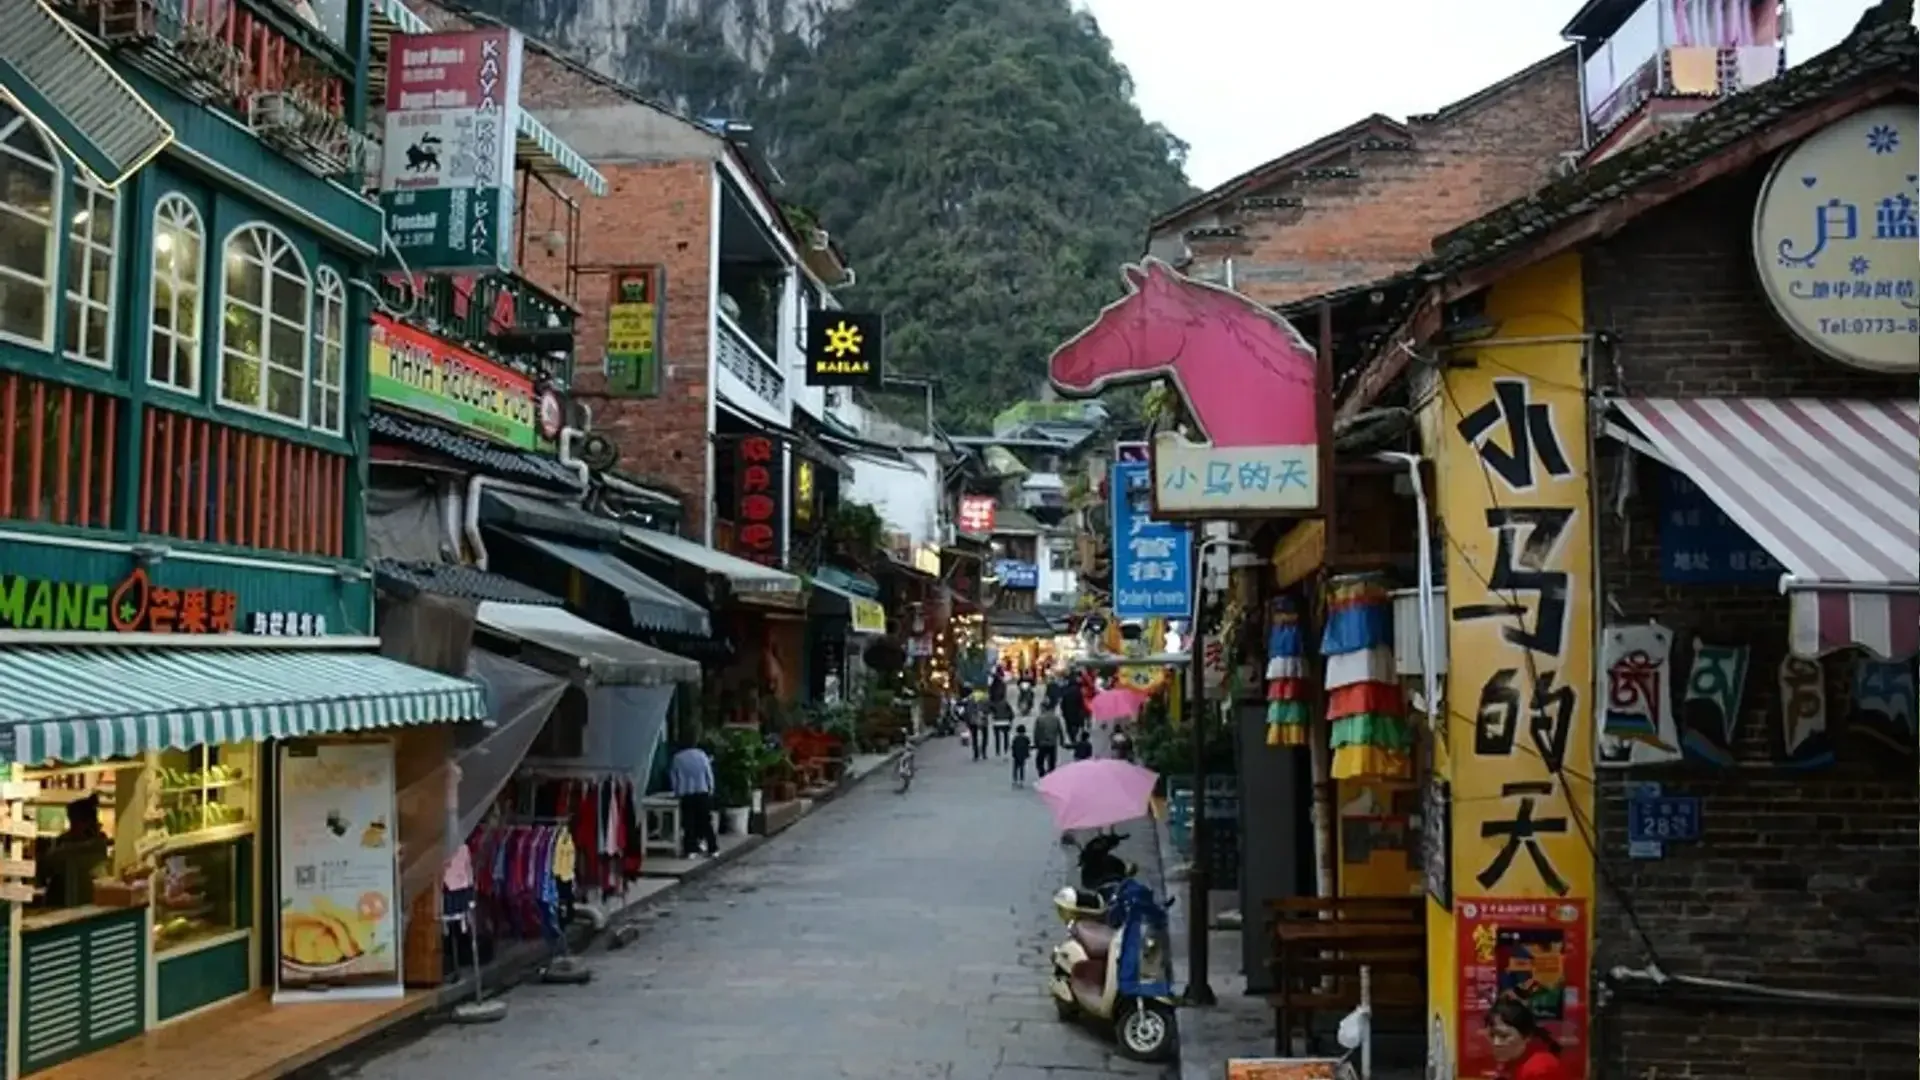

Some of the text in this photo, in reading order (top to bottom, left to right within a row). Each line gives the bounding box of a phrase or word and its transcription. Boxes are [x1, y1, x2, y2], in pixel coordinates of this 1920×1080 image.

[477, 39, 500, 115] KAYA
[470, 200, 490, 256] BAR
[1163, 457, 1308, 496] 小马的天
[1453, 379, 1576, 895] 小马的天
